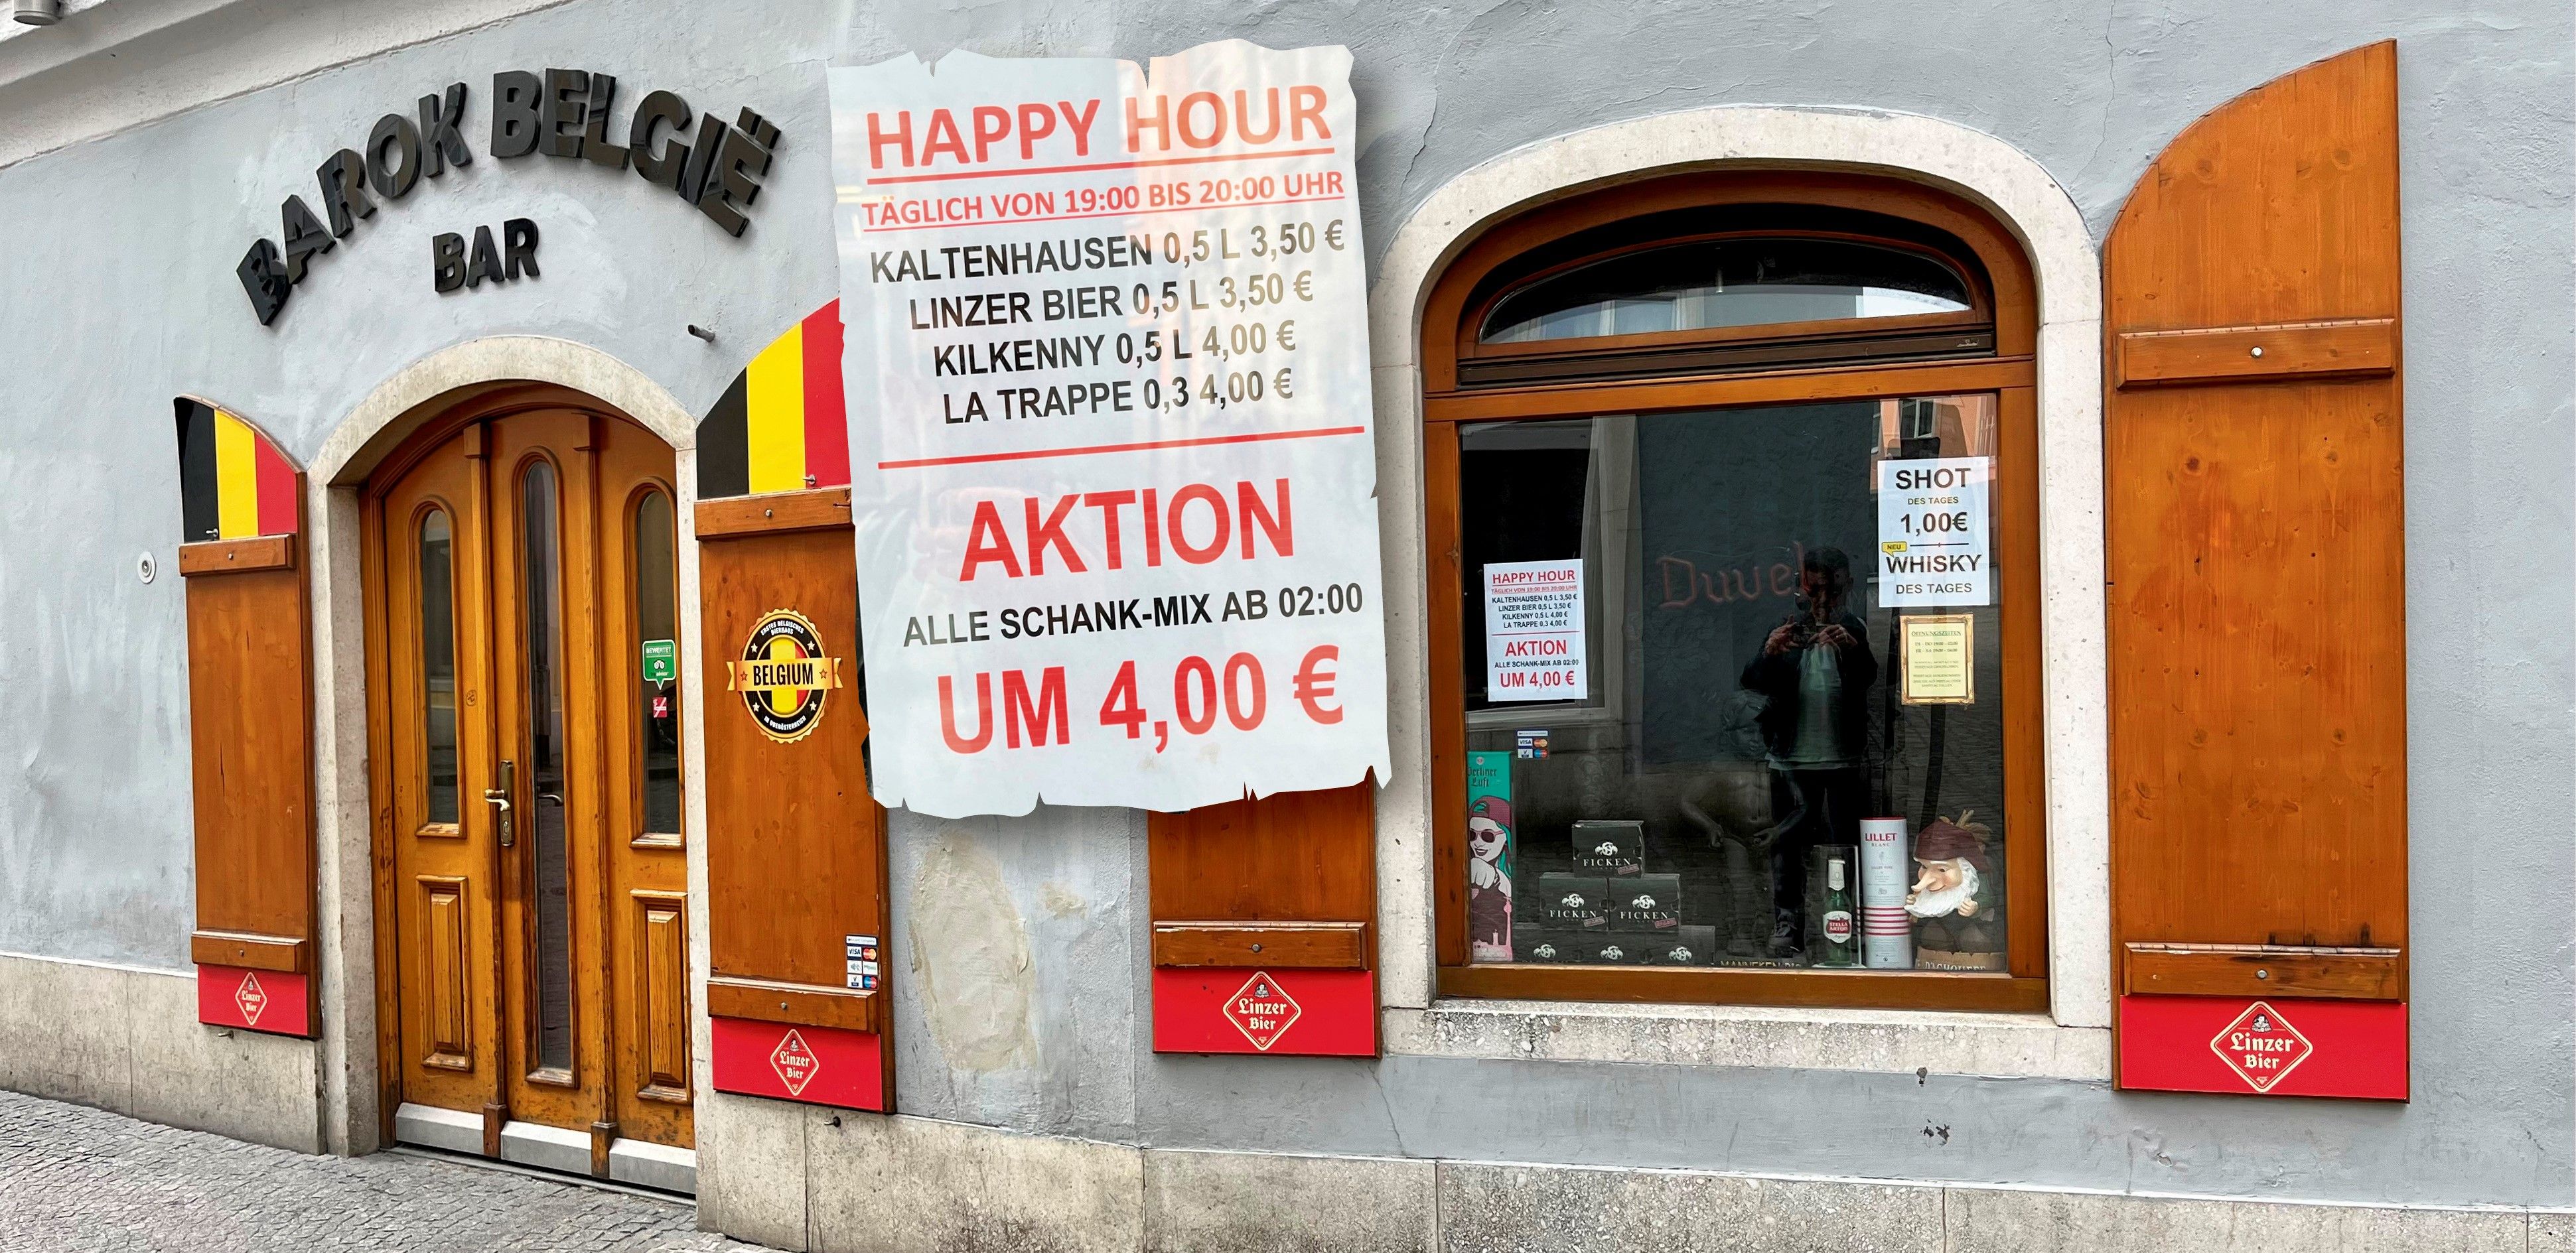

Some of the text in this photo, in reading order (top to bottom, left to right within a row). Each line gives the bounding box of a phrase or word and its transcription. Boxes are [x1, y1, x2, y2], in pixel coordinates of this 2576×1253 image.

[867, 85, 1332, 169] HAPPY HOUR
[236, 68, 782, 327] BAROK BELGIË
[861, 170, 1344, 226] TÄGLICH VON 19:00 BIS 20:00 UHR
[432, 218, 539, 294] BAR
[871, 218, 1344, 283] KALTENHAUSEN 0,5 L 3,50 €
[910, 270, 1313, 330] LINZER BIER 0,5 L 3,50 €
[934, 320, 1296, 376] KILKENNY 0,5 L 4,00 €
[944, 367, 1293, 425] LA TRAPPE 0,3 4,00 €
[1895, 468, 1971, 490] SHOT
[958, 478, 1294, 583] AKTION
[1900, 511, 1968, 537] 1,00€
[1886, 554, 1981, 574] WHISKY
[1493, 570, 1575, 584] HAPPY HOUR
[1896, 583, 1972, 594] DES TAGES
[1492, 595, 1542, 604] KALTENHAUSEN
[903, 582, 1362, 647] ALLE SCHANK-MIX AB 02:00
[1505, 639, 1567, 657] AKTION
[752, 663, 814, 687] BELGIUM
[1500, 670, 1575, 689] UM 4,00 €
[938, 644, 1343, 754] UM 4,00 €
[1865, 832, 1898, 842] LILLET
[1583, 858, 1630, 866] FICKEN
[1549, 909, 1597, 918] FICKEN
[241, 990, 262, 1002] Linzer
[1238, 998, 1287, 1015] Linzer
[1248, 1016, 1277, 1030] Bier
[2230, 1032, 2295, 1052] Linzer
[779, 1050, 810, 1067] Linzer
[2244, 1053, 2280, 1069] Bier
[786, 1067, 804, 1079] Bier
